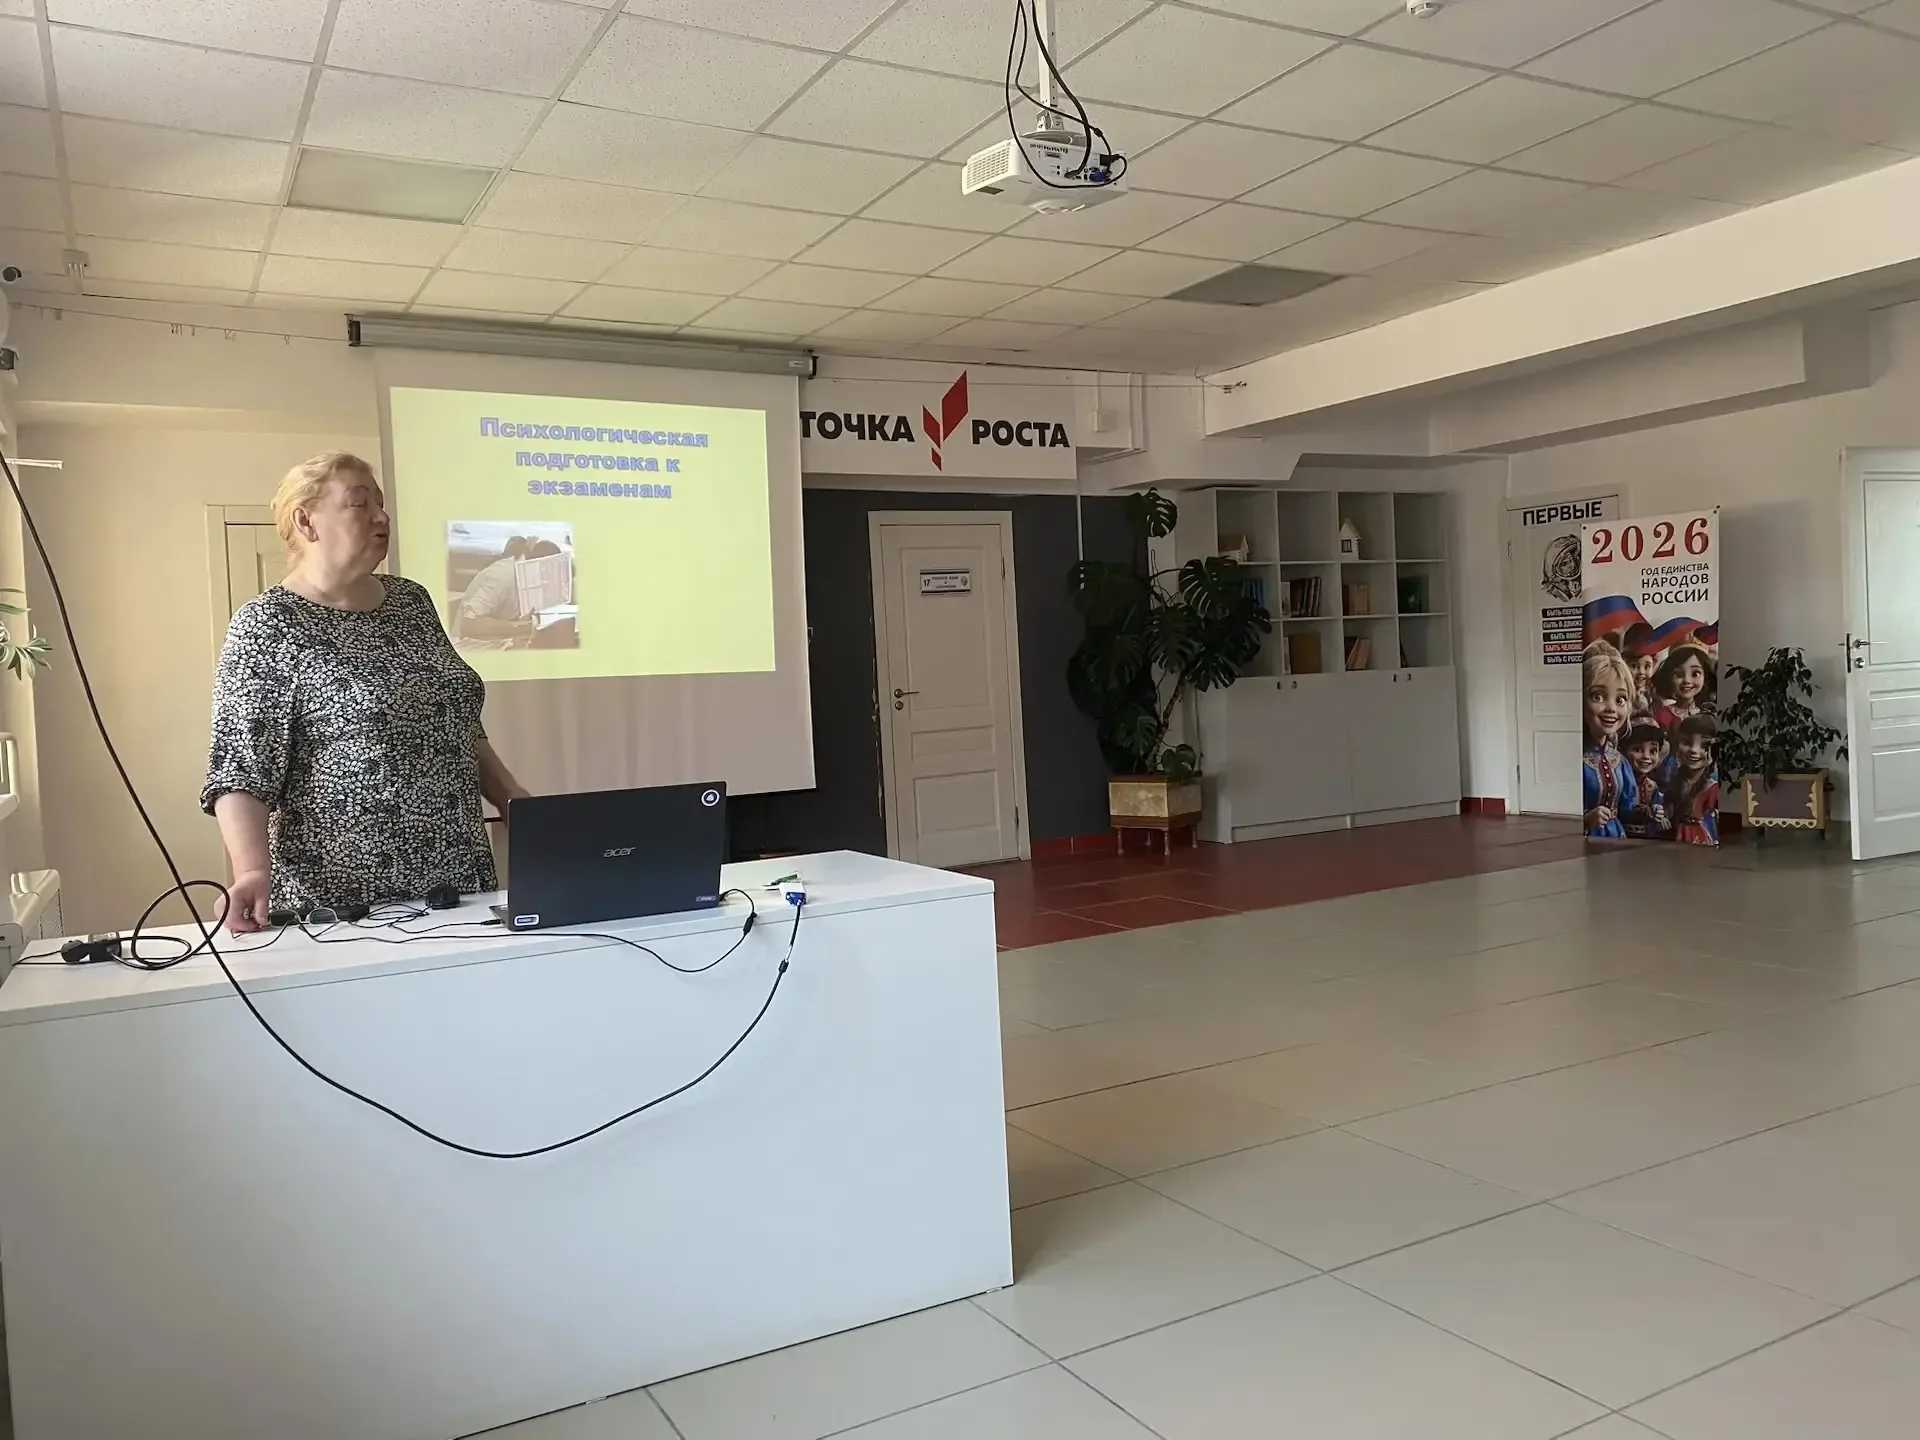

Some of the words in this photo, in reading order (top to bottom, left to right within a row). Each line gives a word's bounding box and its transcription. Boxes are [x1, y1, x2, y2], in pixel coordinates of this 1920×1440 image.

[480, 416, 709, 447] Психологическая
[800, 411, 915, 443] ТОЧКА
[971, 419, 1070, 448] РОСТА
[515, 451, 659, 472] подготовка
[665, 457, 681, 473] к
[527, 479, 672, 499] экзаменам
[1523, 501, 1602, 526] ПЕРВЫЕ
[1591, 517, 1709, 564] 2026
[1641, 567, 1659, 576] ГОД
[1661, 563, 1709, 575] ЕДИНСТВА
[923, 578, 931, 587] 17
[1641, 573, 1709, 588] НАРОДОВ
[1641, 588, 1709, 605] РОССИИ
[603, 846, 636, 858] acer
